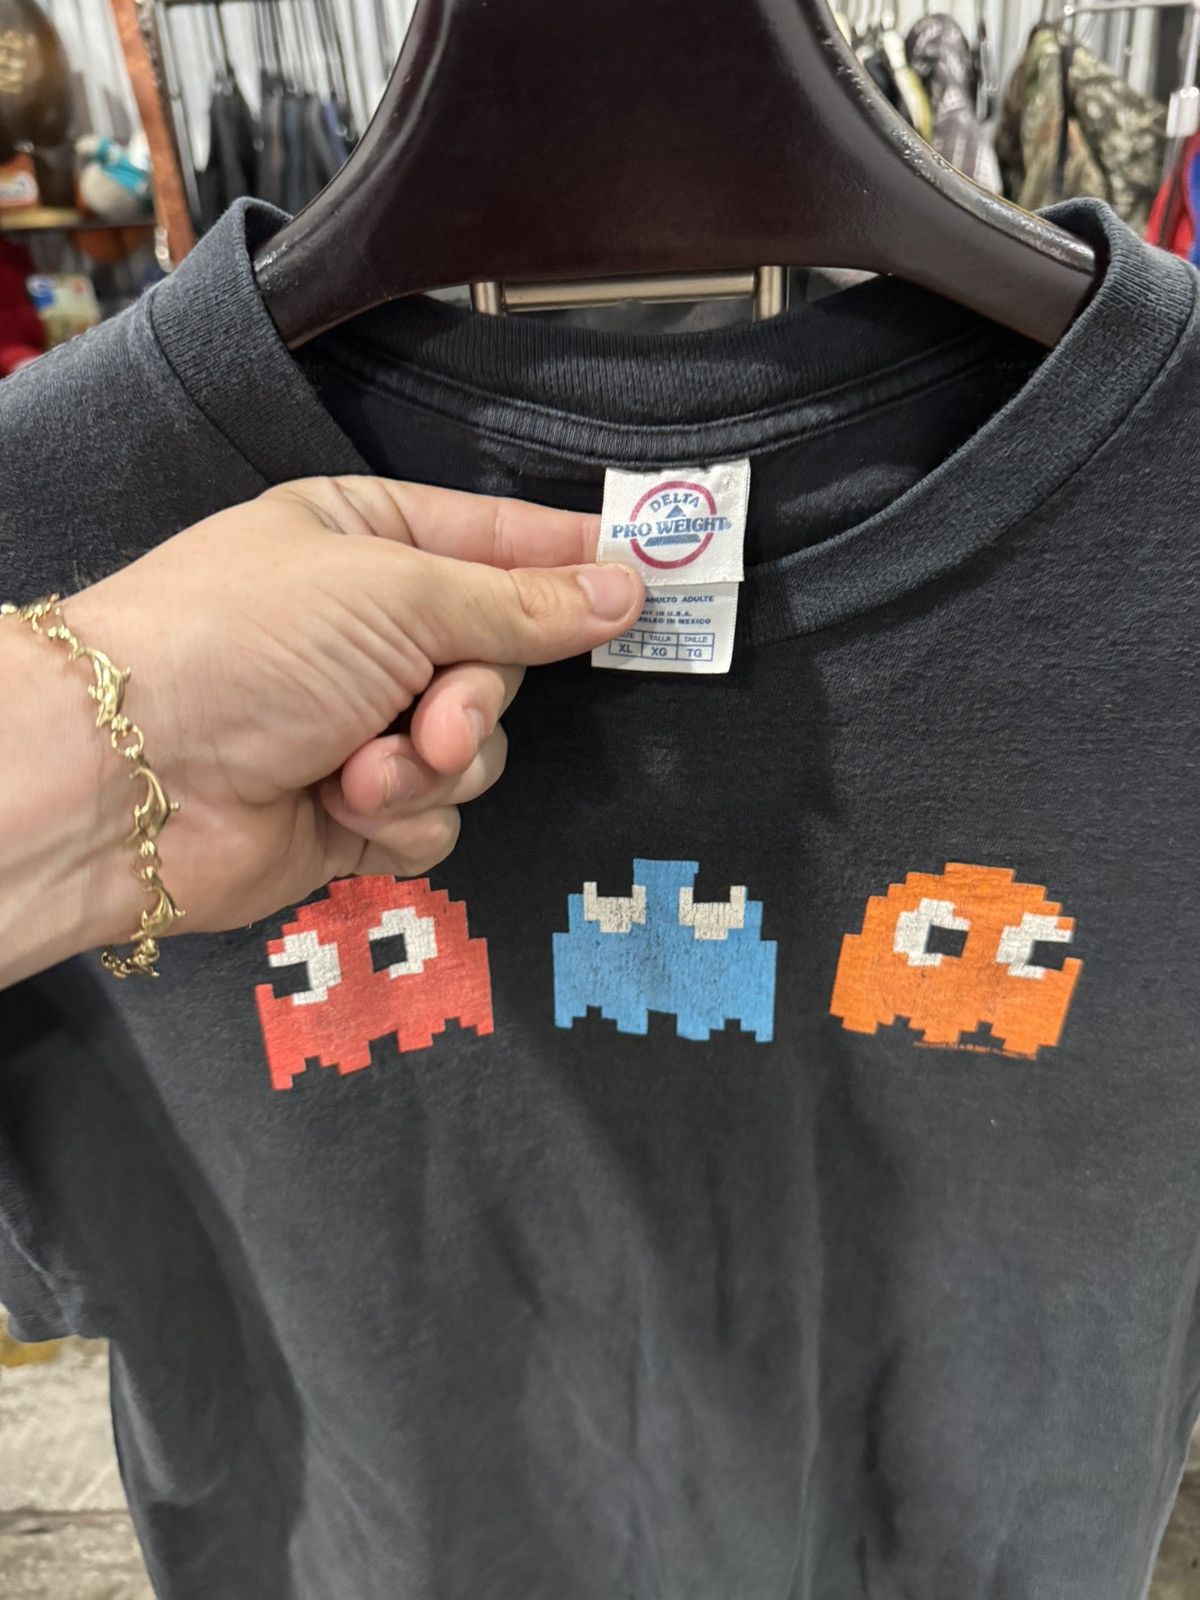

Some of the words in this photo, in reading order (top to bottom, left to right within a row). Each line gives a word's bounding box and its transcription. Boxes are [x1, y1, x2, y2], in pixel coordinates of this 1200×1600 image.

[649, 492, 699, 513] DELTA
[611, 521, 652, 538] PRO
[656, 516, 727, 535] WEIGHT
[645, 596, 678, 604] ADULTO
[682, 595, 714, 603] ADULTE
[649, 634, 672, 643] TALLA
[684, 635, 708, 644] TAILLE
[618, 643, 633, 654] XL
[651, 646, 668, 657] XG
[686, 648, 703, 658] TG
